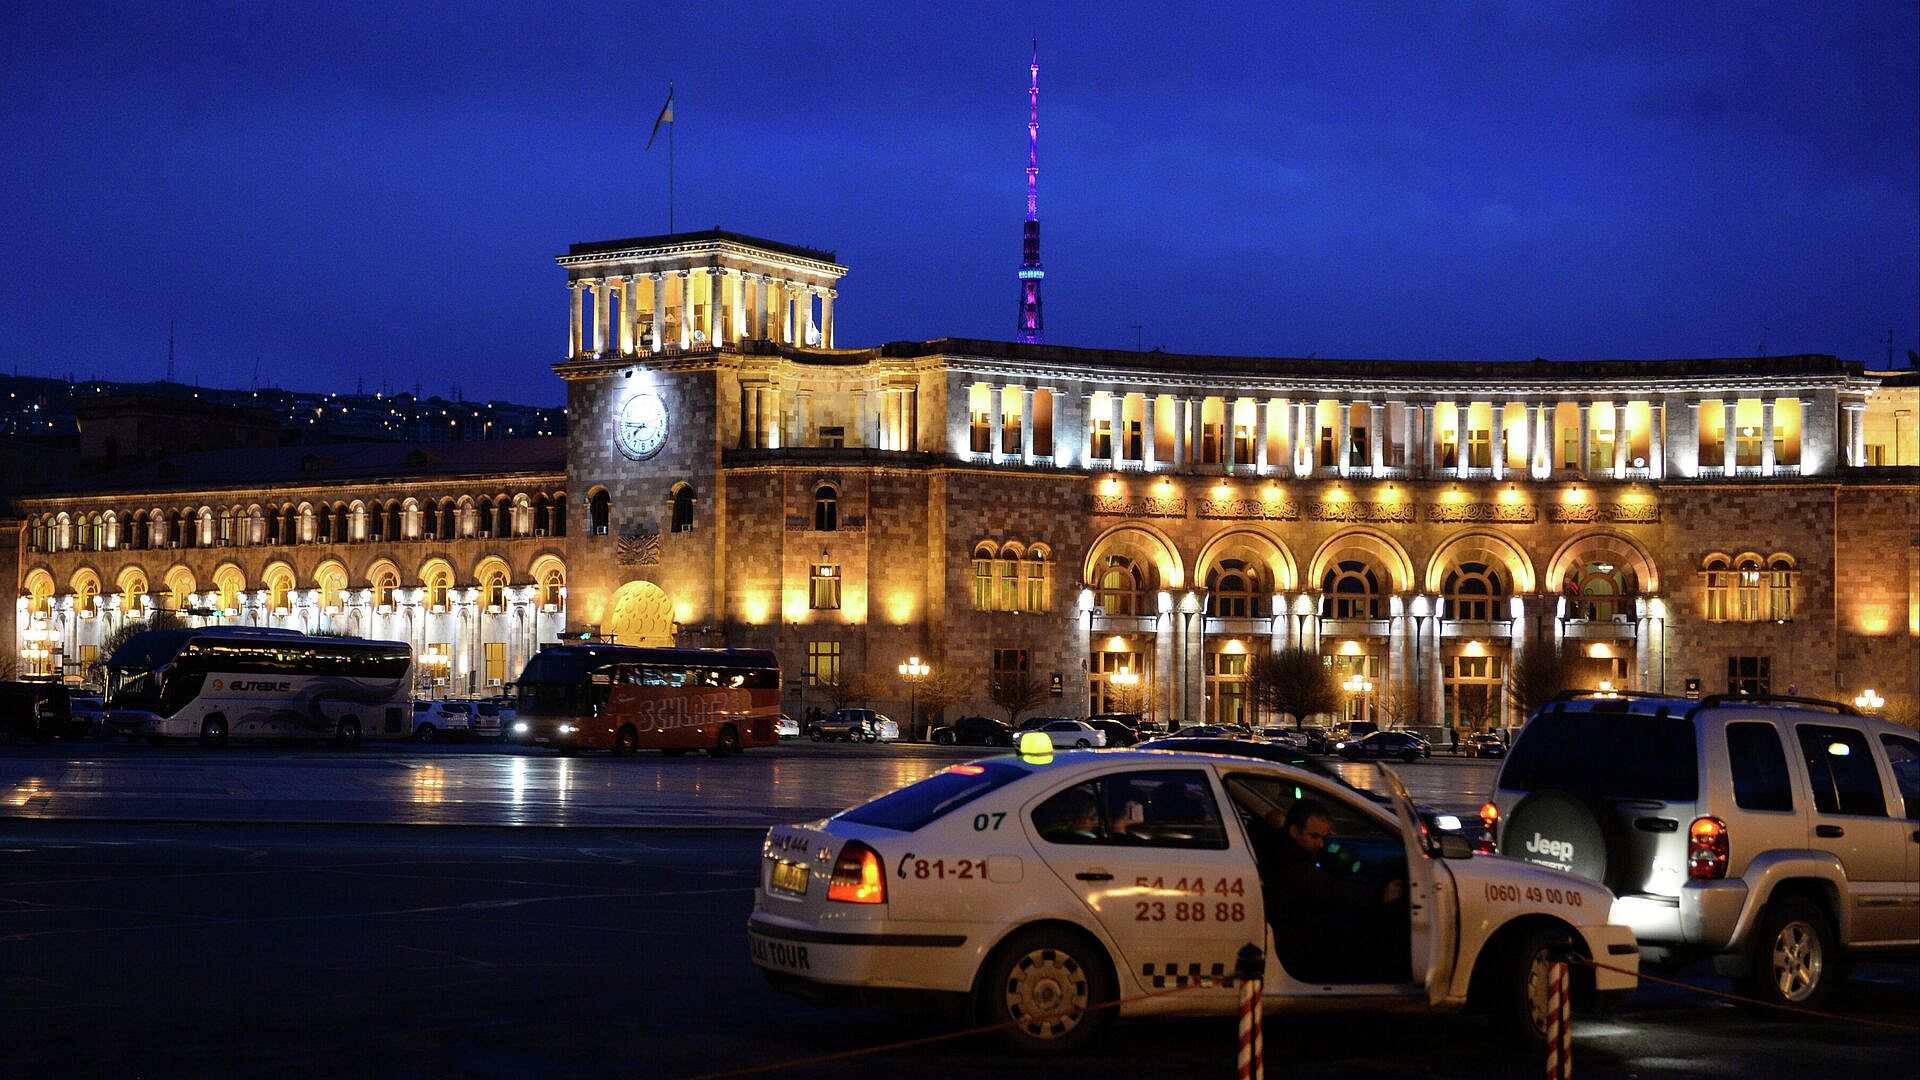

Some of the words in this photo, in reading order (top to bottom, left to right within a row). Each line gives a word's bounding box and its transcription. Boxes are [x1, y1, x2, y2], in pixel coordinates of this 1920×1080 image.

[230, 681, 291, 692] ELITEBUS
[973, 812, 1007, 832] 07
[1526, 832, 1575, 862] Jeep
[914, 859, 987, 880] 81-21
[1175, 877, 1205, 896] 44
[1214, 877, 1245, 897] 44
[1485, 882, 1521, 903] (060)
[1526, 886, 1542, 902] 49
[1546, 888, 1562, 905] 00
[1566, 890, 1582, 906] 00
[1135, 902, 1166, 921] 23
[1176, 902, 1206, 922] 88
[1215, 902, 1245, 922] 88
[768, 941, 810, 969] TOUR
